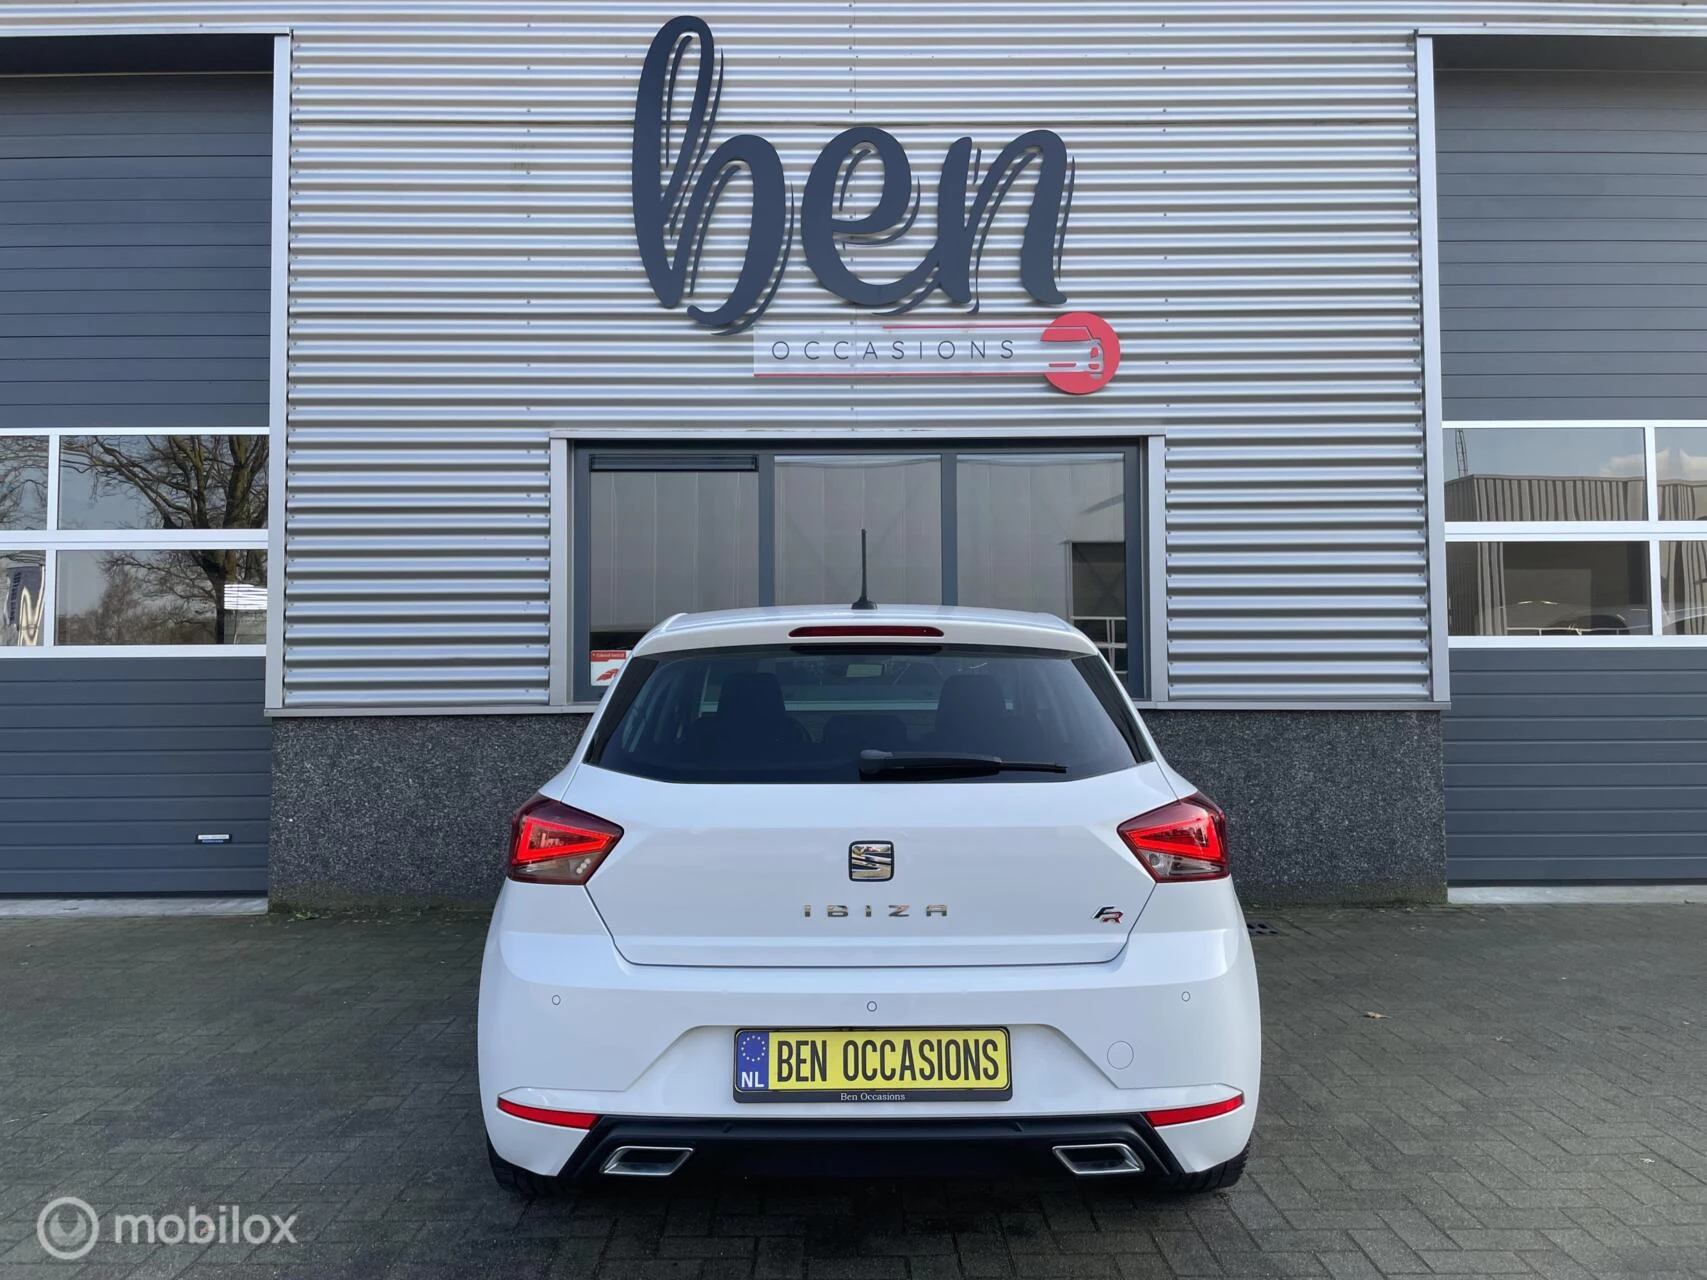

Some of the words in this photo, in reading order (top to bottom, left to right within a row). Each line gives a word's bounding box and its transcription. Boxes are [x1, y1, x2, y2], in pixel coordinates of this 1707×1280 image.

[632, 15, 1075, 335] ben
[771, 340, 1016, 361] OCCASIONS
[803, 904, 948, 917] IBIZA
[1091, 905, 1124, 923] FR
[741, 1071, 765, 1088] NL
[777, 1040, 827, 1082] BEN
[842, 1038, 999, 1082] OCCASIONS
[840, 1092, 858, 1101] Ben
[860, 1092, 906, 1101] Occasions
